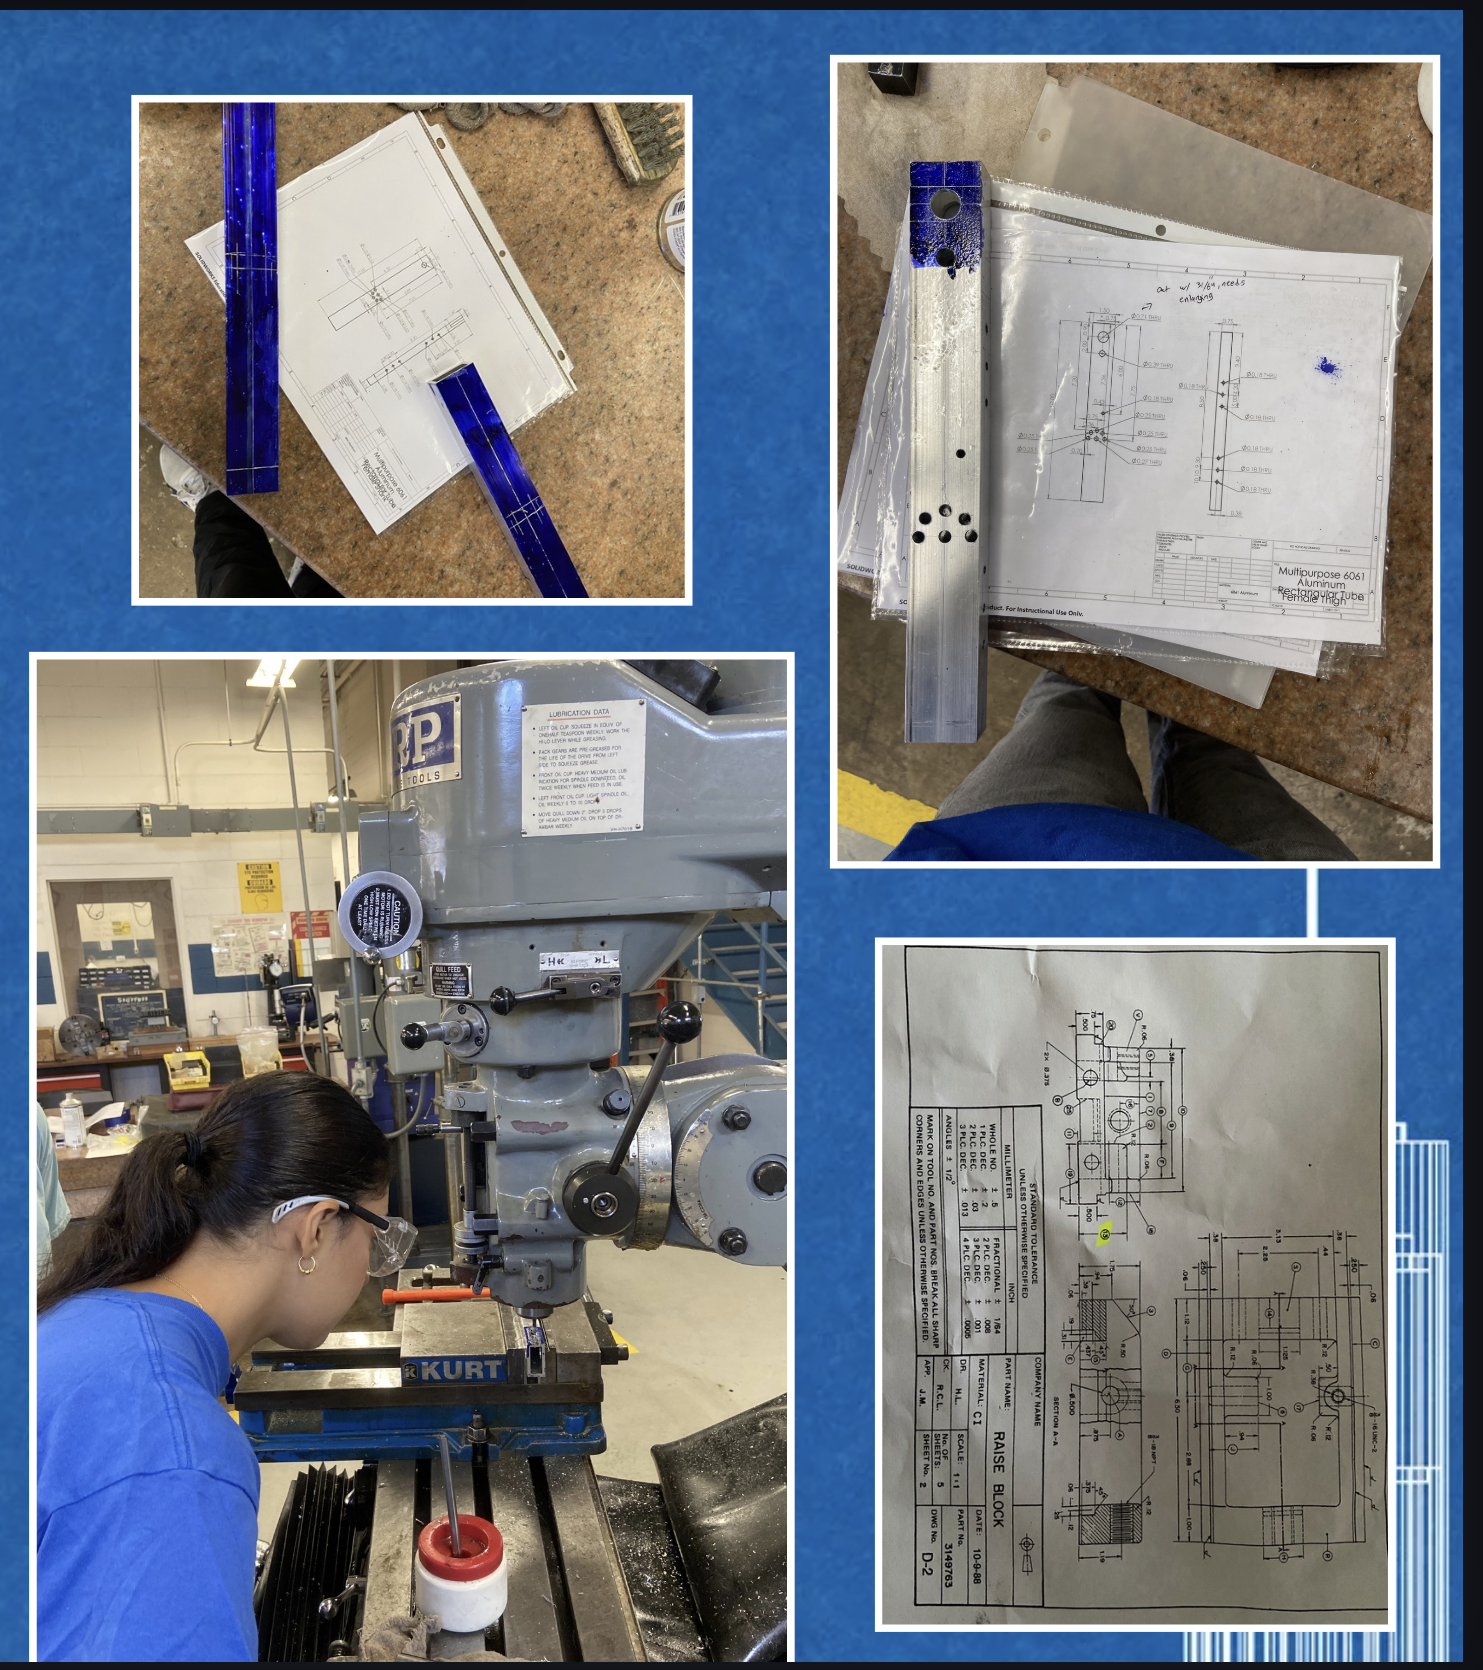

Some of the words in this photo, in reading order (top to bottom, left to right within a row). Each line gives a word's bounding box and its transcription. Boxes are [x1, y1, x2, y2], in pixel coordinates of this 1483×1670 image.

[1278, 566, 1341, 579] Multipurpose
[1344, 572, 1365, 580] 6061
[1297, 578, 1346, 589] Aluminum
[1017, 606, 1054, 616] Instructional
[549, 710, 590, 718] LUBRICATION
[393, 901, 401, 935] CAUTION
[926, 1114, 934, 1140] MARK
[927, 1143, 934, 1155] ON
[1004, 1144, 1012, 1199] MILLIMETER
[1030, 1183, 1038, 1230] STANDARD
[1020, 1204, 1028, 1253] OTHERWISE
[921, 1298, 929, 1343] SPECIFIED.
[422, 1360, 502, 1380] KURT
[942, 1450, 948, 1460] OF
[993, 1431, 1005, 1473] RAISE
[993, 1484, 1004, 1527] BLOCK
[922, 1552, 933, 1576] D-2
[944, 1543, 953, 1588] 3149763
[973, 1548, 981, 1584] 10-9-88
